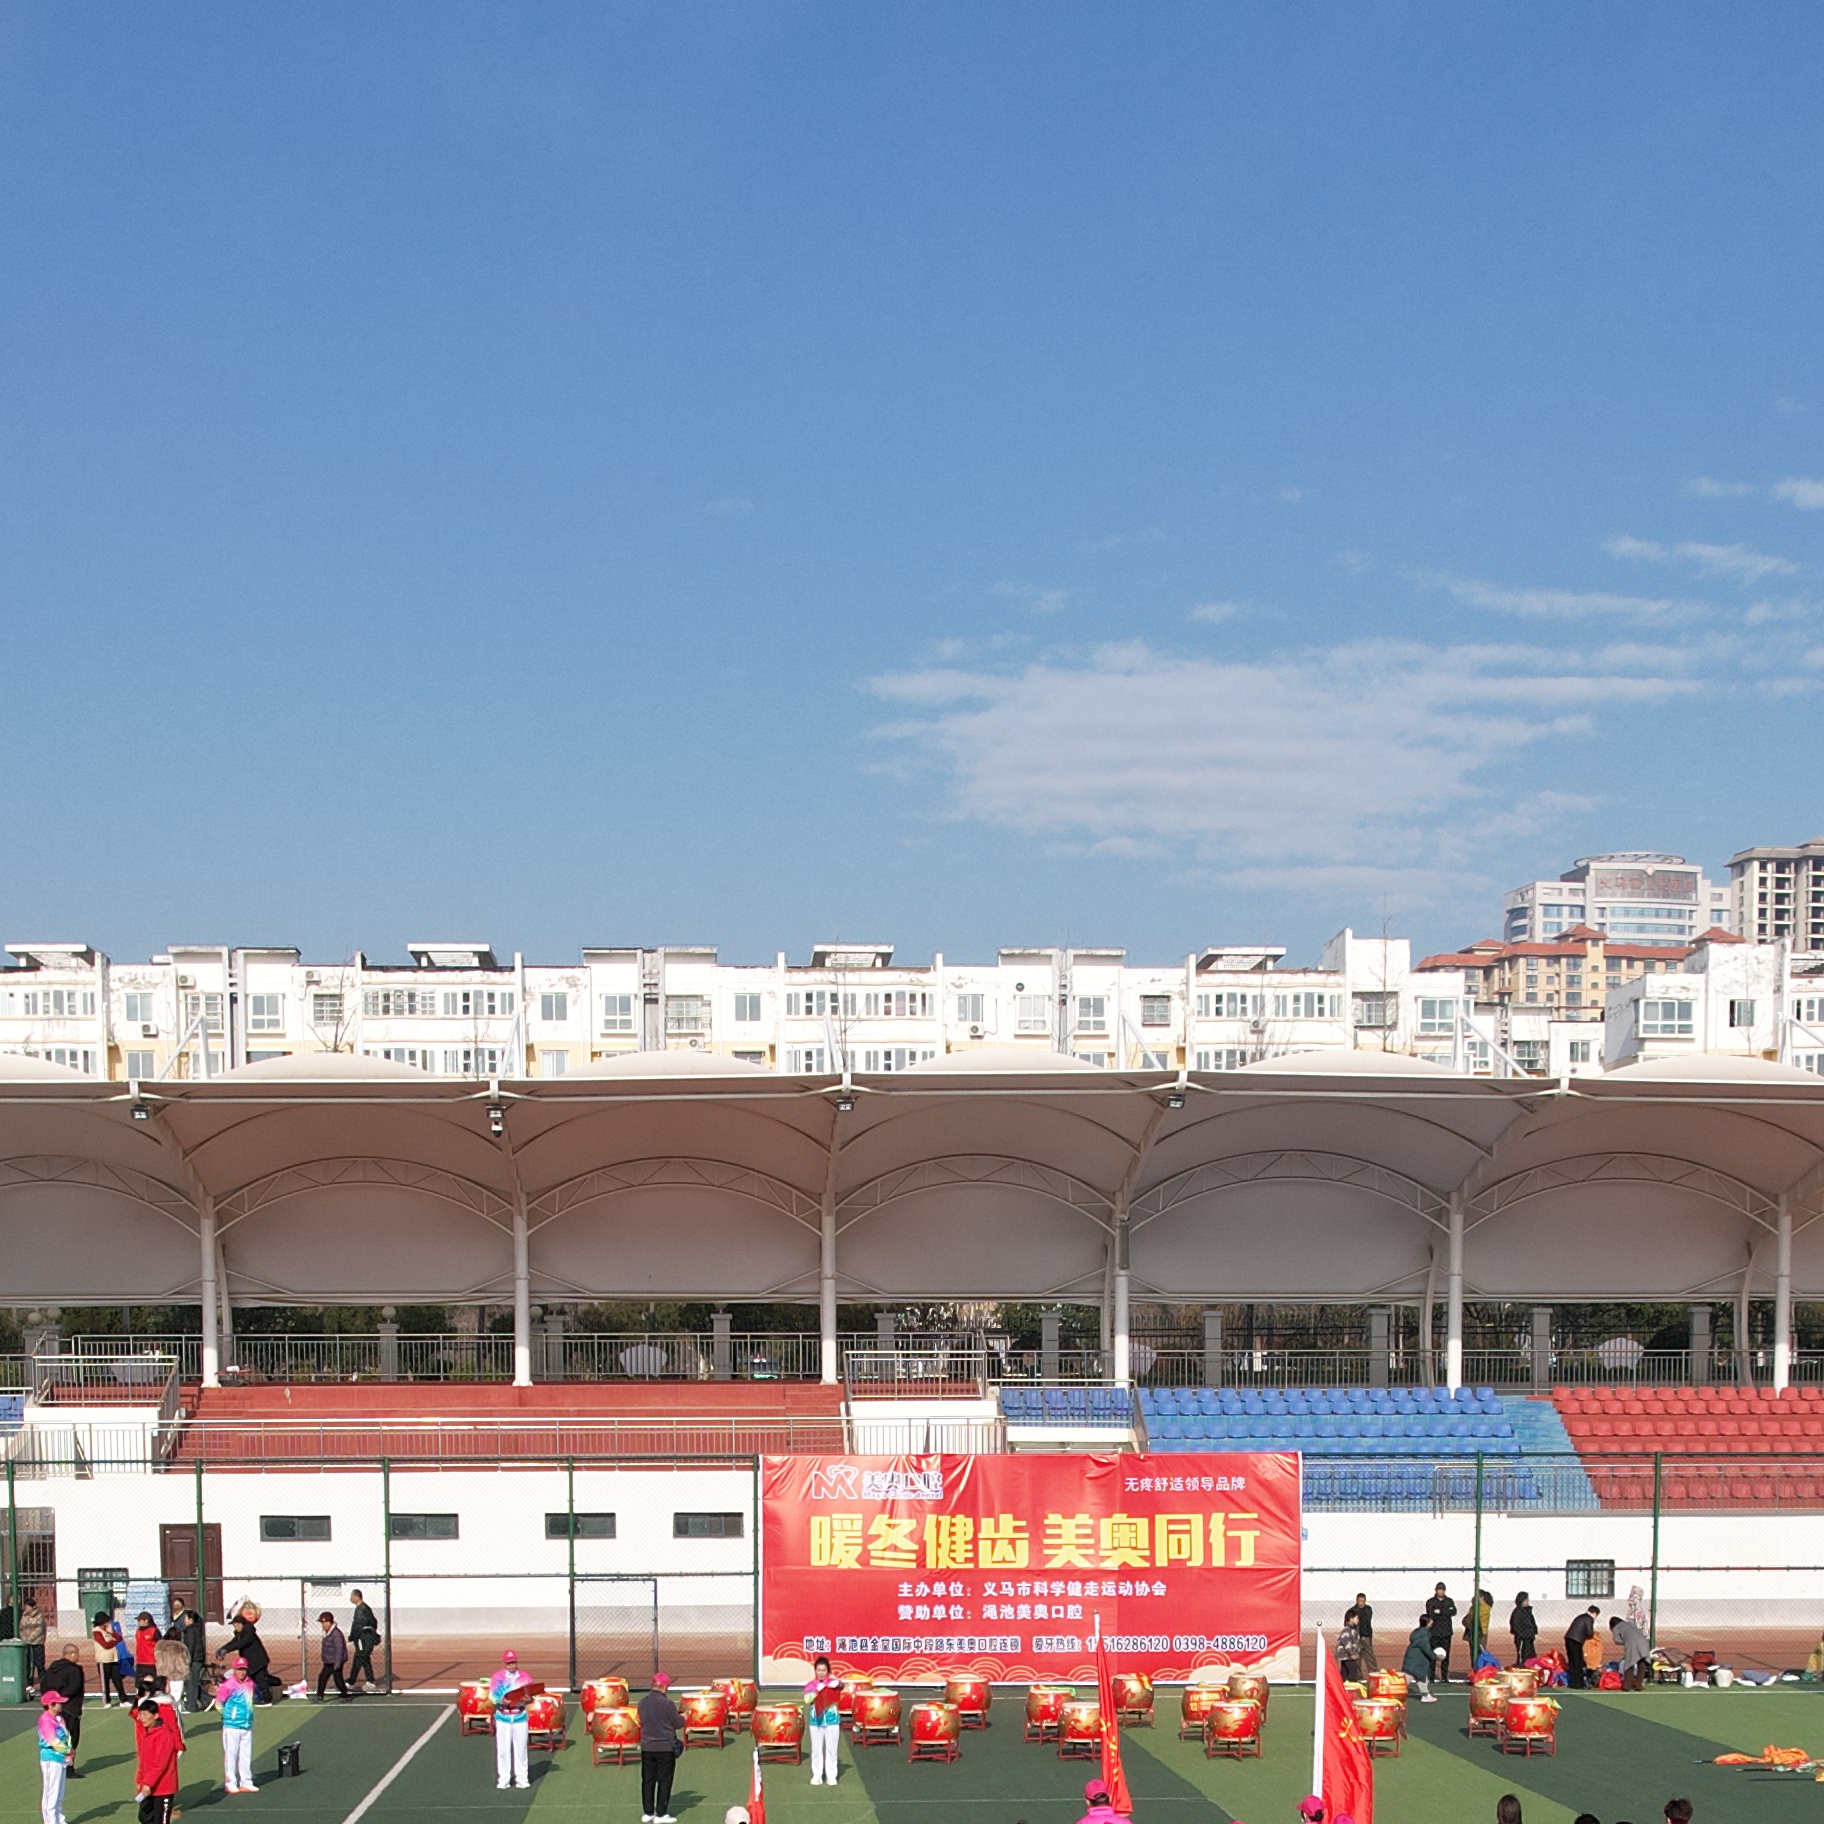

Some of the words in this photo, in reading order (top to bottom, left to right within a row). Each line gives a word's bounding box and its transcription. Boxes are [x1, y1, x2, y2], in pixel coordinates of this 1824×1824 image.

[1124, 1476, 1246, 1492] 无疼舒适领导品牌
[810, 1513, 1030, 1569] 暖冬健齿
[1042, 1512, 1261, 1569] 美奥同行
[982, 1581, 1167, 1597] 义马市科学健走运动协会
[982, 1604, 1083, 1620] 渑池美奥口腔
[1174, 1636, 1267, 1651] 0398-4886120
